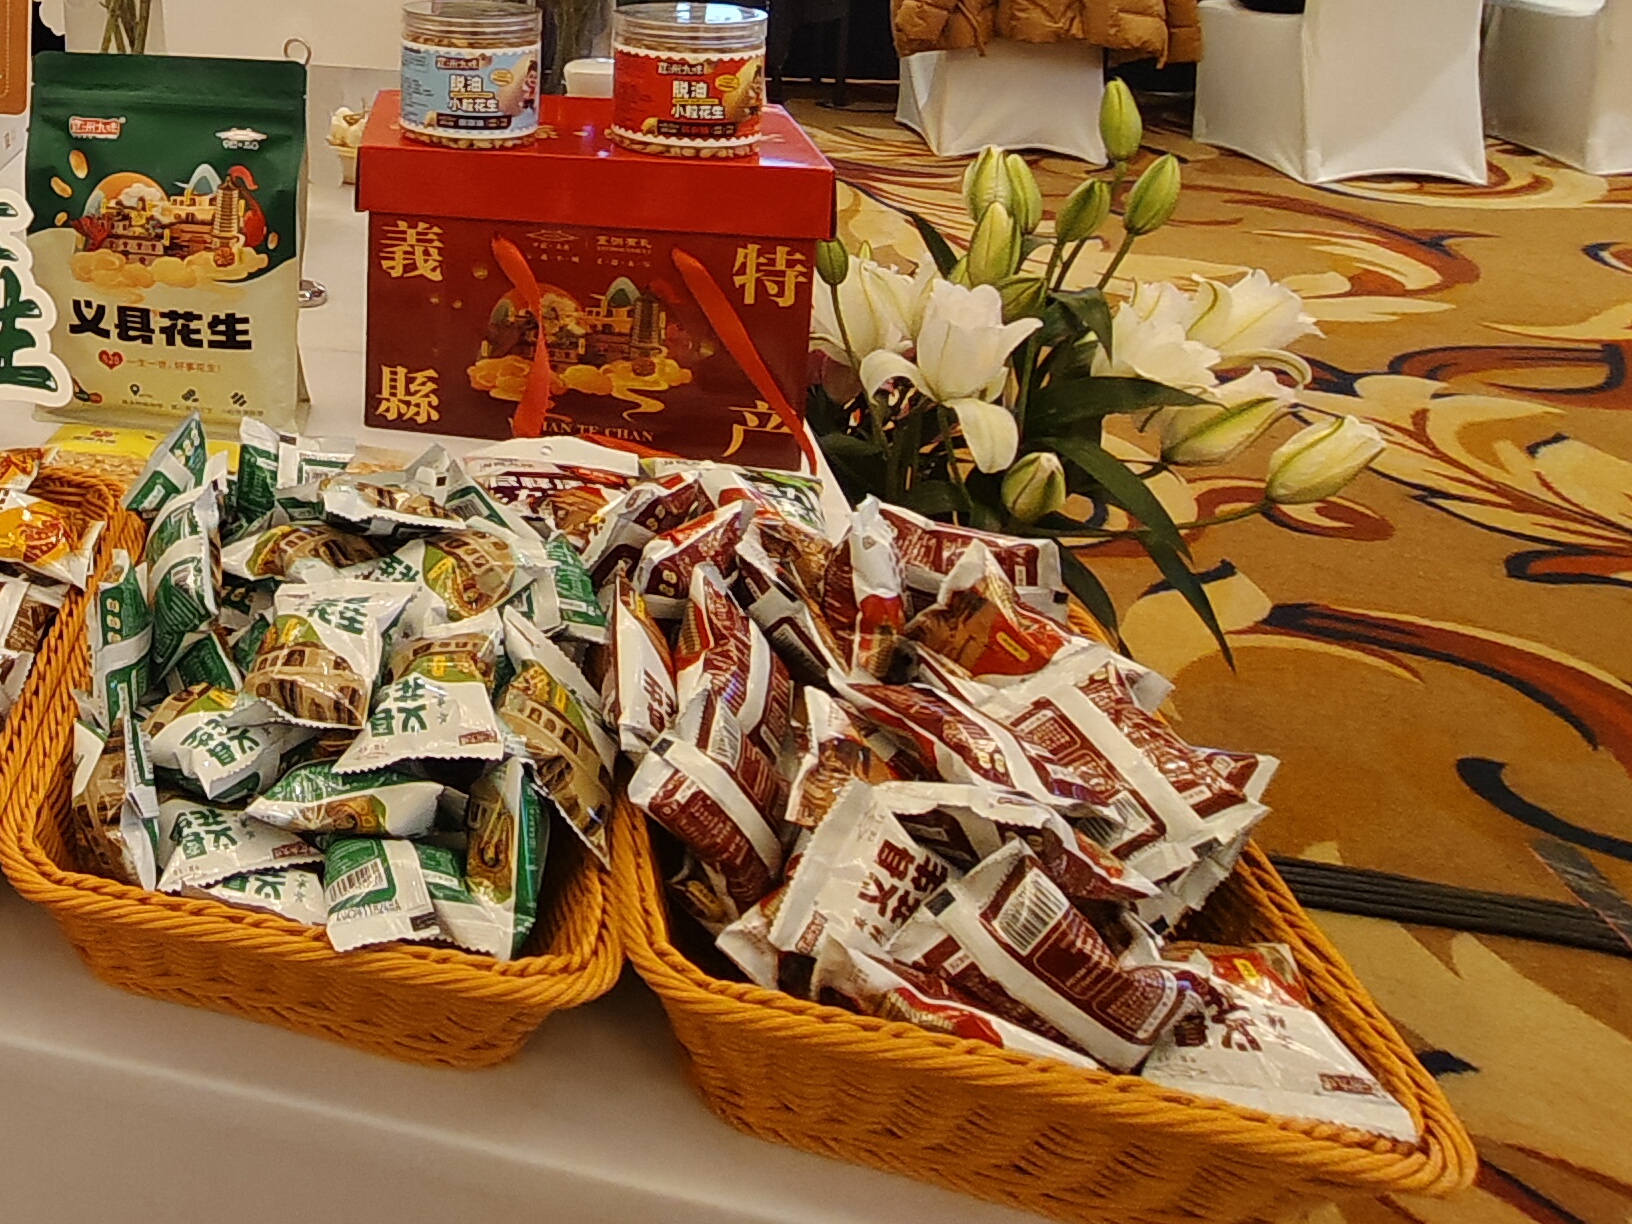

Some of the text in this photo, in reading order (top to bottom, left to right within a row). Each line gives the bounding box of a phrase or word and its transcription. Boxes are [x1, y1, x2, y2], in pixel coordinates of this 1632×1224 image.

[449, 74, 483, 93] 脱油
[672, 79, 708, 100] 脱油
[448, 97, 499, 113] 小粒花生
[670, 104, 726, 120] 小粒花生
[68, 298, 253, 350] 义县花生
[603, 426, 655, 443] CHAN
